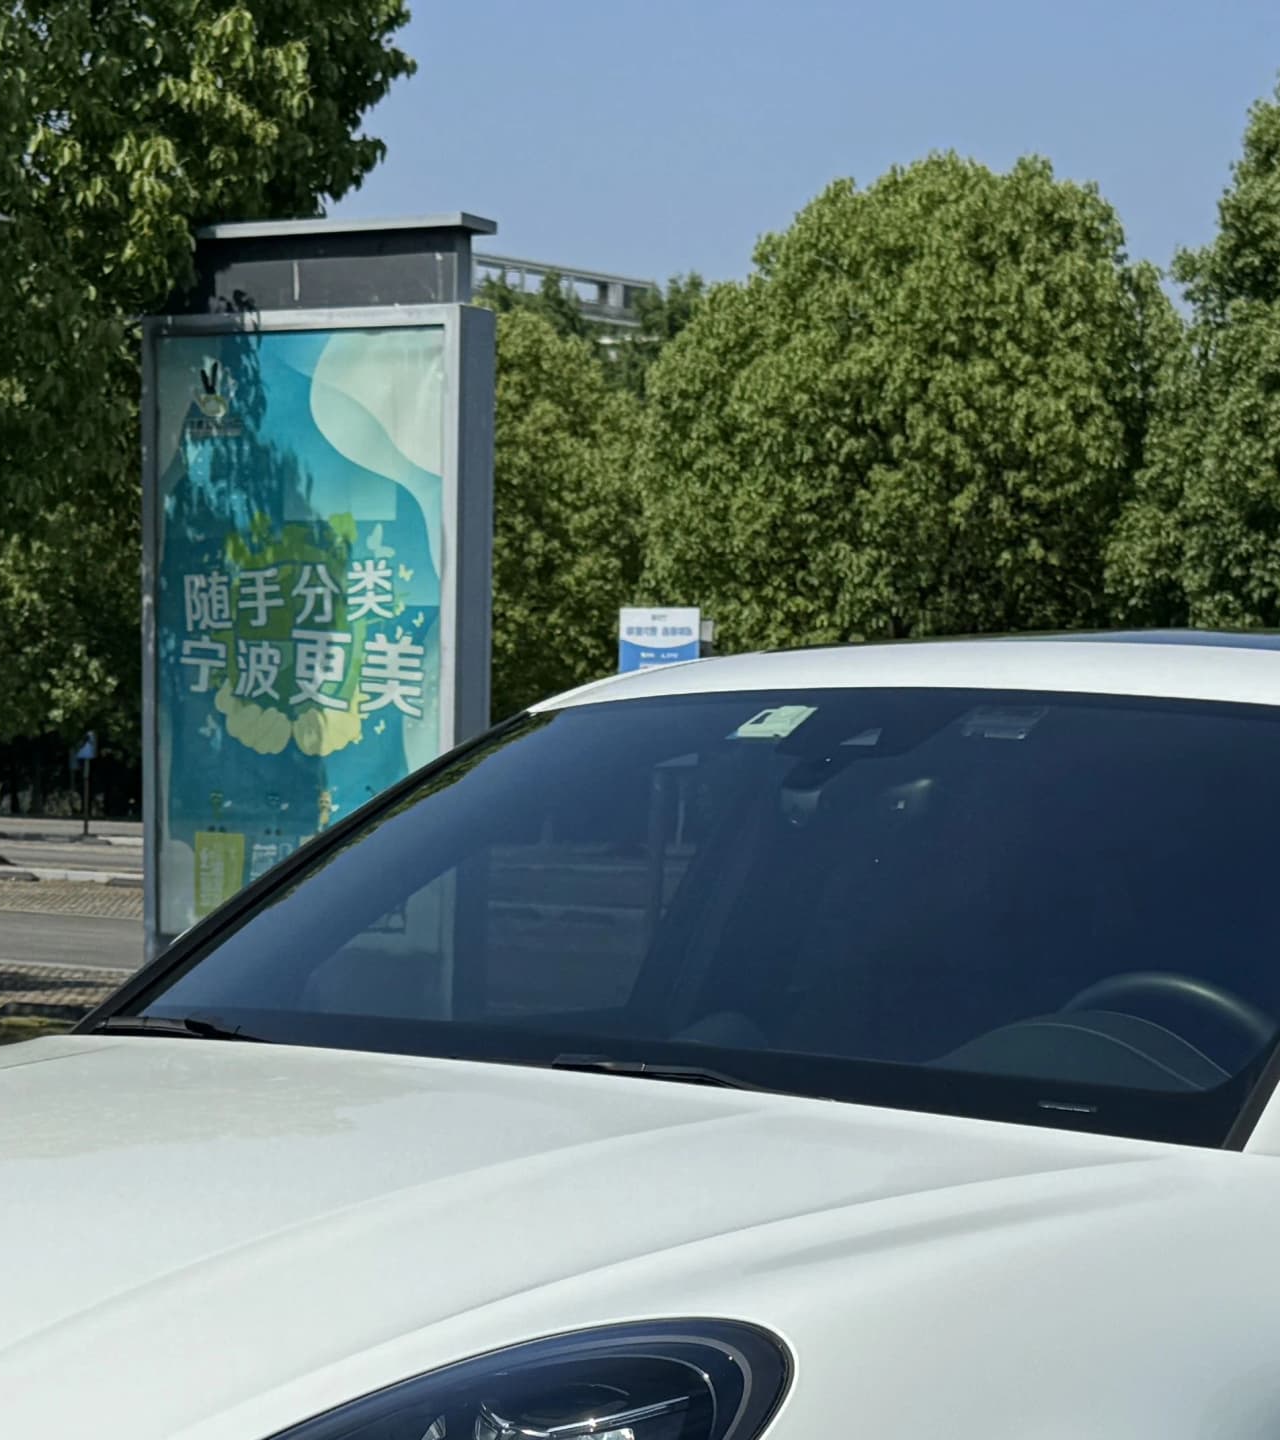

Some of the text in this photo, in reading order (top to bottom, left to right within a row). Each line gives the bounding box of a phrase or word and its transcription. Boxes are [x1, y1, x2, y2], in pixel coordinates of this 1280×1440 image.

[184, 559, 394, 632] 随手分类
[180, 629, 424, 718] 宁波更美
